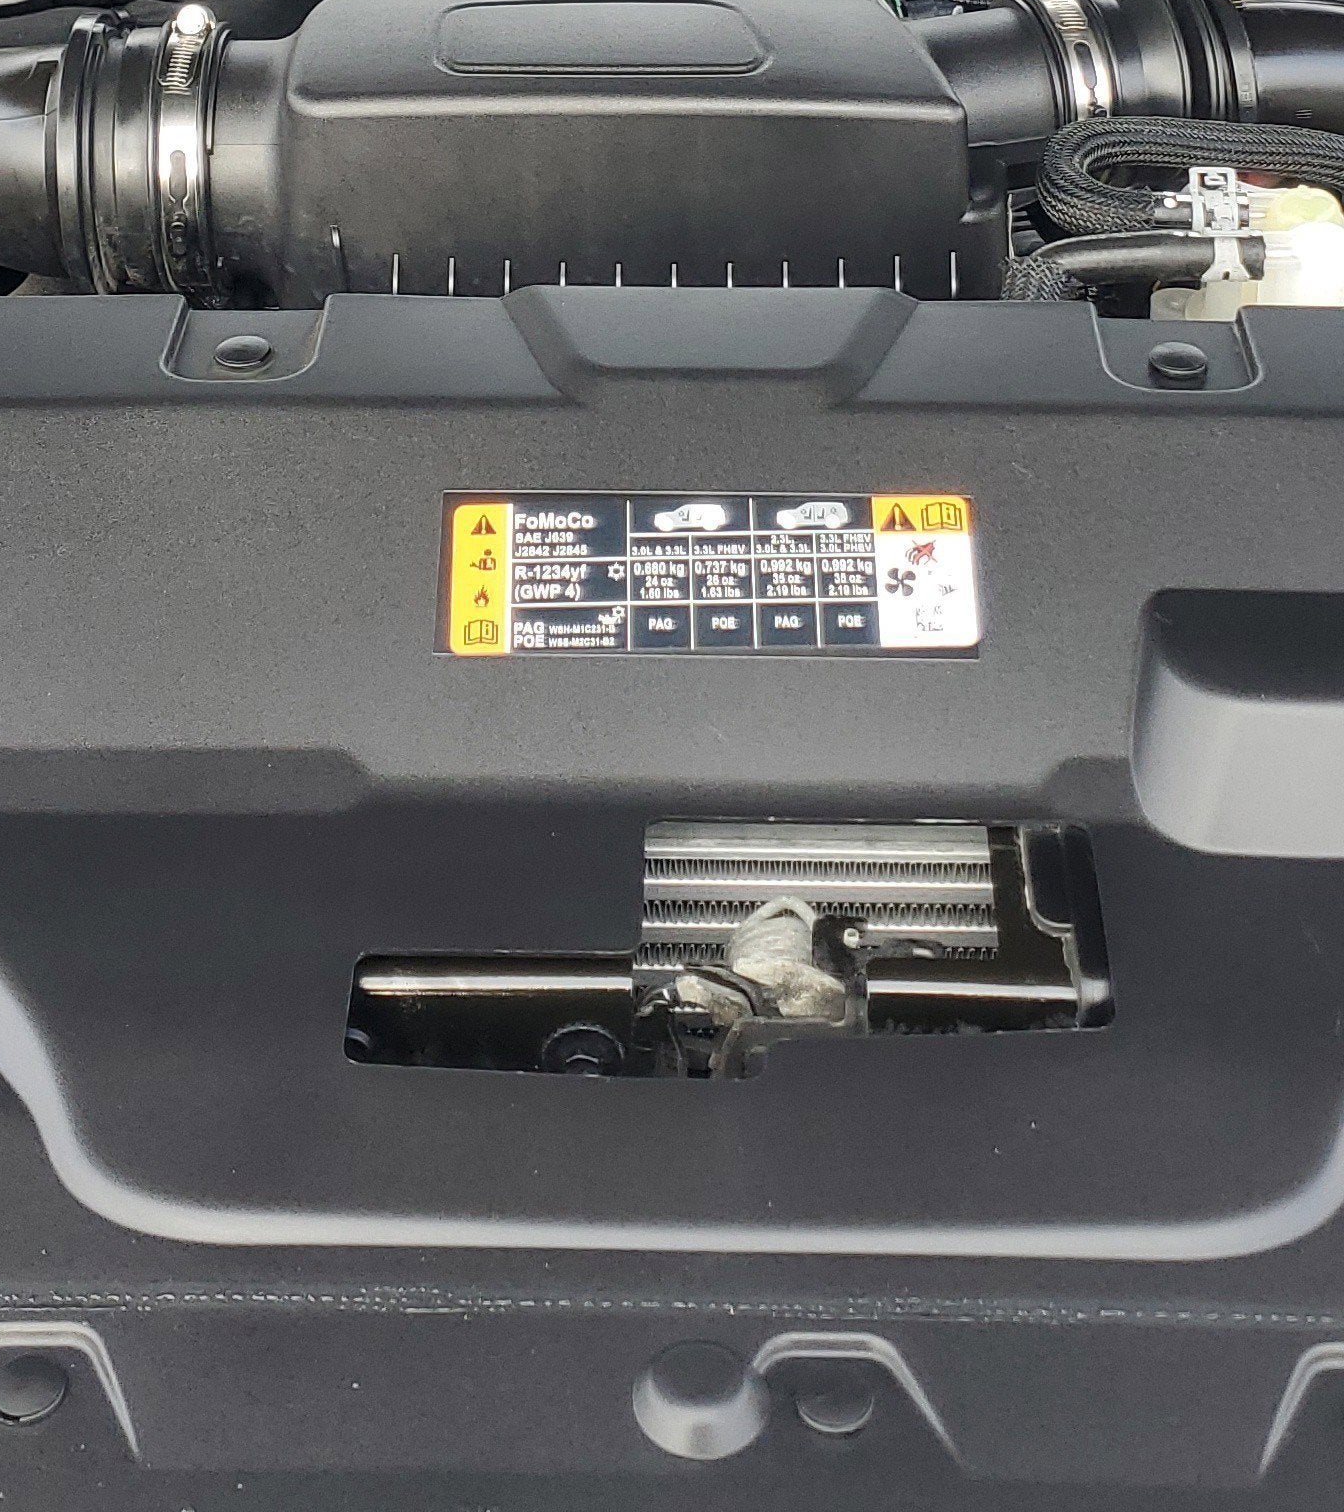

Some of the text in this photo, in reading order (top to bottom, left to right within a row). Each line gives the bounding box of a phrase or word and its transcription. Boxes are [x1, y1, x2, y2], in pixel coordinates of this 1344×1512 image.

[514, 511, 594, 530] FoMoCo
[515, 531, 574, 544] SAE J639
[514, 544, 588, 557] J2842 J2845
[631, 546, 653, 556] 3.0L
[655, 545, 663, 555] &
[756, 544, 777, 554] 3.0L
[779, 544, 788, 554] &
[819, 543, 842, 553] 3.0L
[514, 563, 587, 582] R-1234yf
[669, 561, 685, 578] kg
[694, 560, 746, 577] 0.737 kg
[760, 558, 812, 576] 0.992 kg
[856, 558, 873, 575] kg
[645, 575, 658, 588] 24
[514, 582, 581, 603] (GWP 4)
[663, 587, 680, 599] lbs
[724, 586, 741, 598] lbs
[790, 584, 808, 596] lbs
[851, 584, 869, 595] lbs
[513, 621, 545, 635] PAG
[648, 616, 673, 630] PAG
[711, 616, 736, 629] POE
[774, 615, 799, 628] PAG
[837, 615, 862, 628] POE
[513, 634, 545, 648] POE
